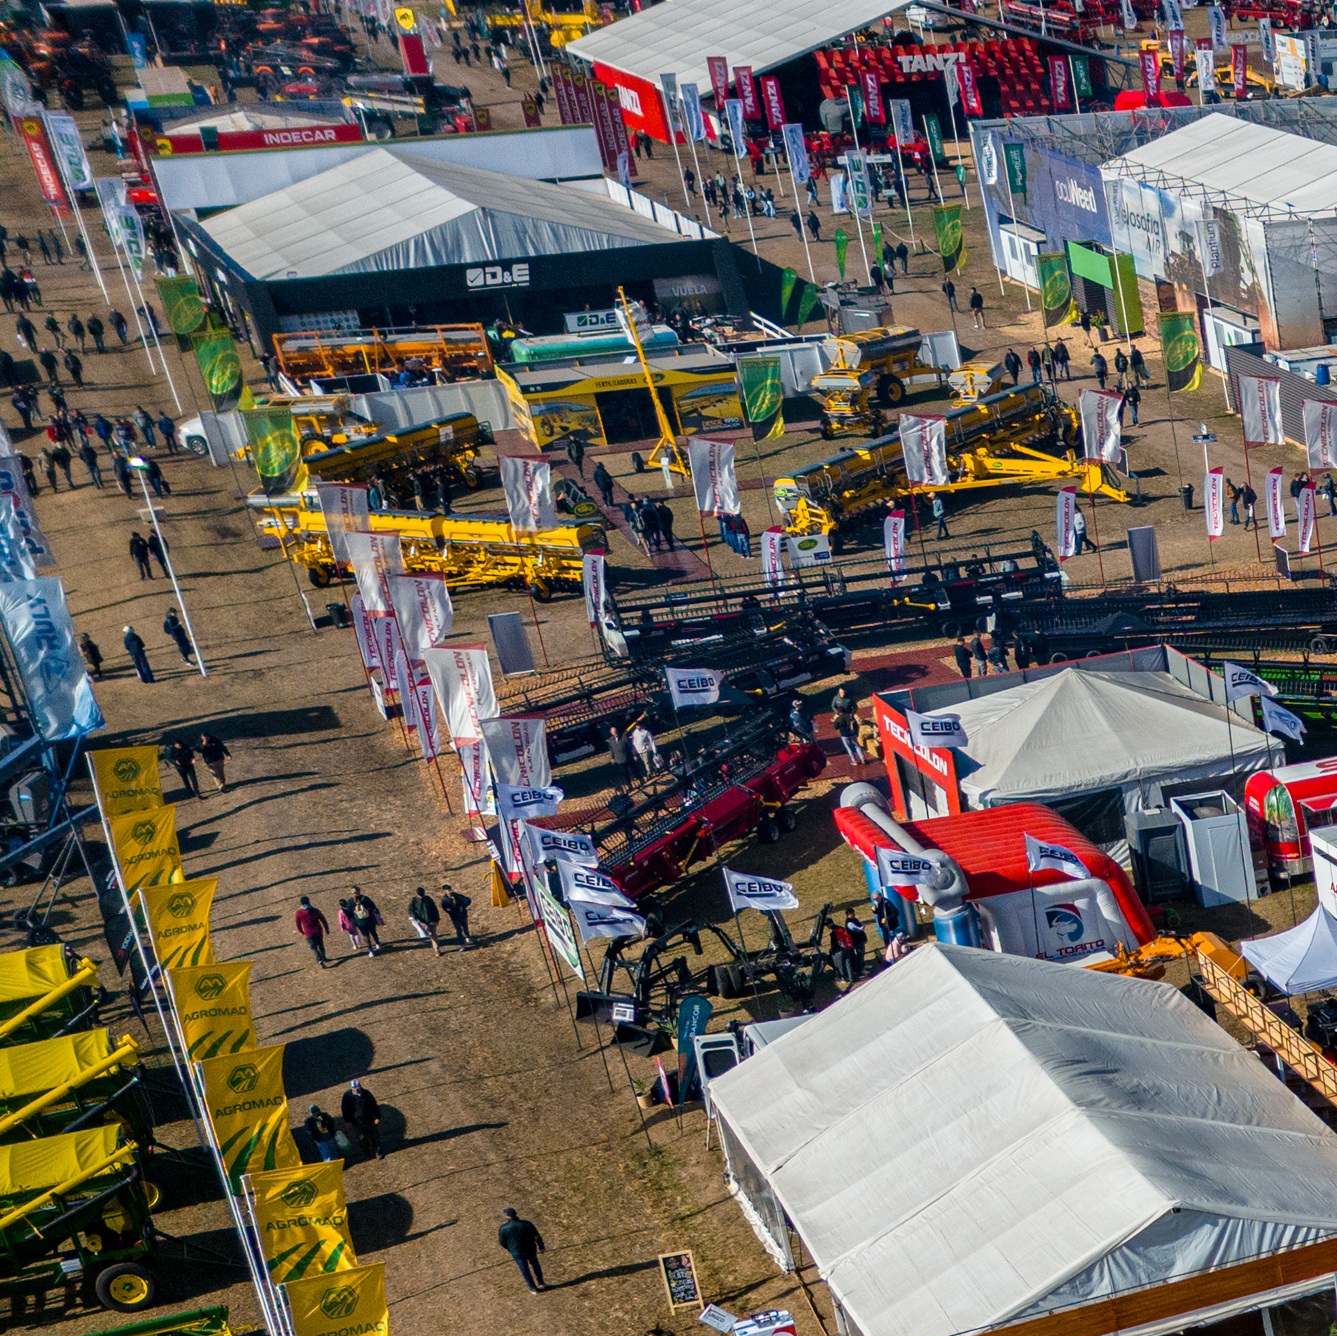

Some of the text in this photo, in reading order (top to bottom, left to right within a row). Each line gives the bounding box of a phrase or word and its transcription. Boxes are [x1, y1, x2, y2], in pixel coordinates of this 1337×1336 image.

[740, 71, 754, 114] TANZI
[764, 81, 782, 123] TANZI
[864, 73, 879, 120] TANZI
[960, 64, 978, 113] TANZI
[1053, 62, 1068, 104] TANZI
[263, 130, 336, 145] INDECAR
[1211, 223, 1220, 269] Plantium
[676, 677, 714, 693] CEIBO
[883, 715, 948, 775] TECNCOLON
[919, 720, 961, 733] CEIBO
[540, 835, 590, 852] CEIBO
[888, 858, 933, 870] CEIBO
[734, 881, 784, 896] CEIBO
